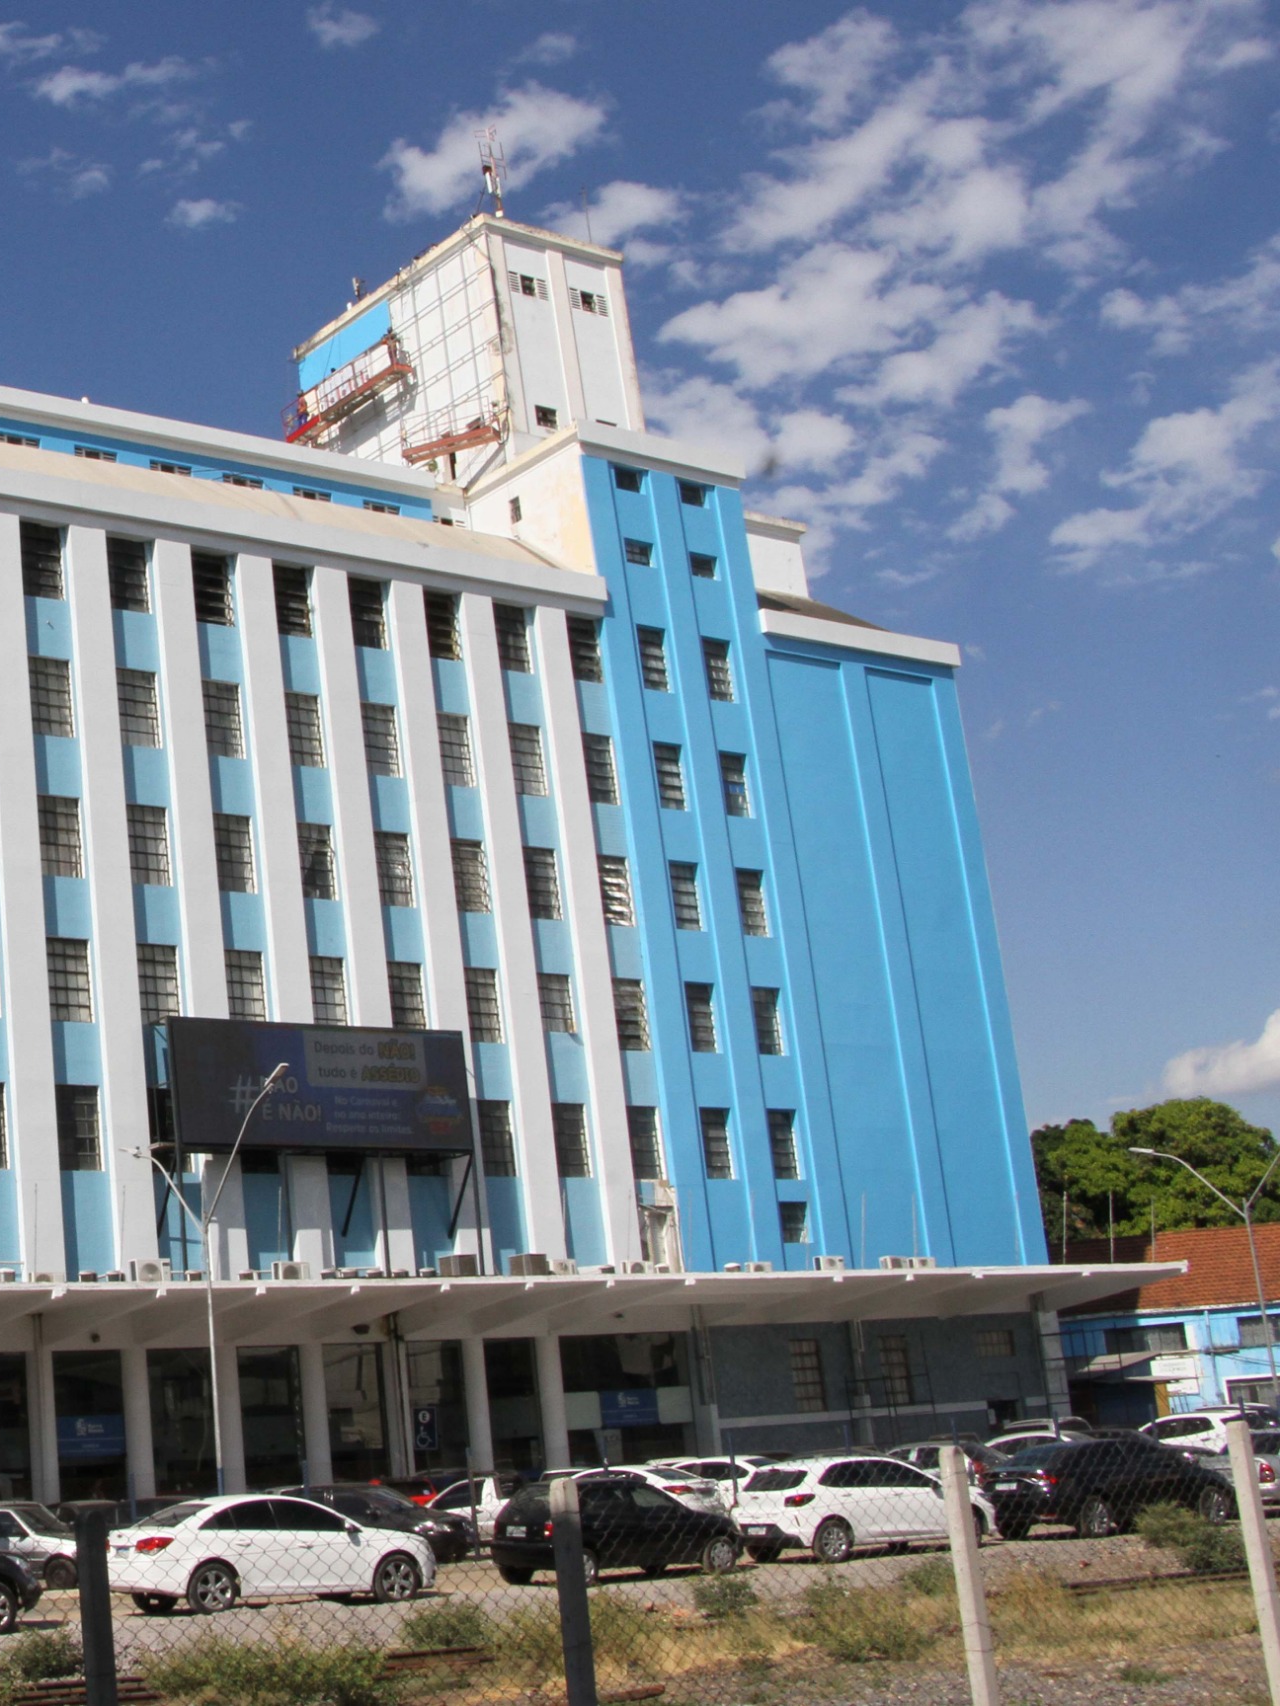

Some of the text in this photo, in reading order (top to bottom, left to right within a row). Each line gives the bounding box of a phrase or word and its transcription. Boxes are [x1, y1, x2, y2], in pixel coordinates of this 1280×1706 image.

[314, 1038, 416, 1060] Depois do NÃO!
[318, 1066, 347, 1078] tudo
[262, 1098, 322, 1122] É NÃO!
